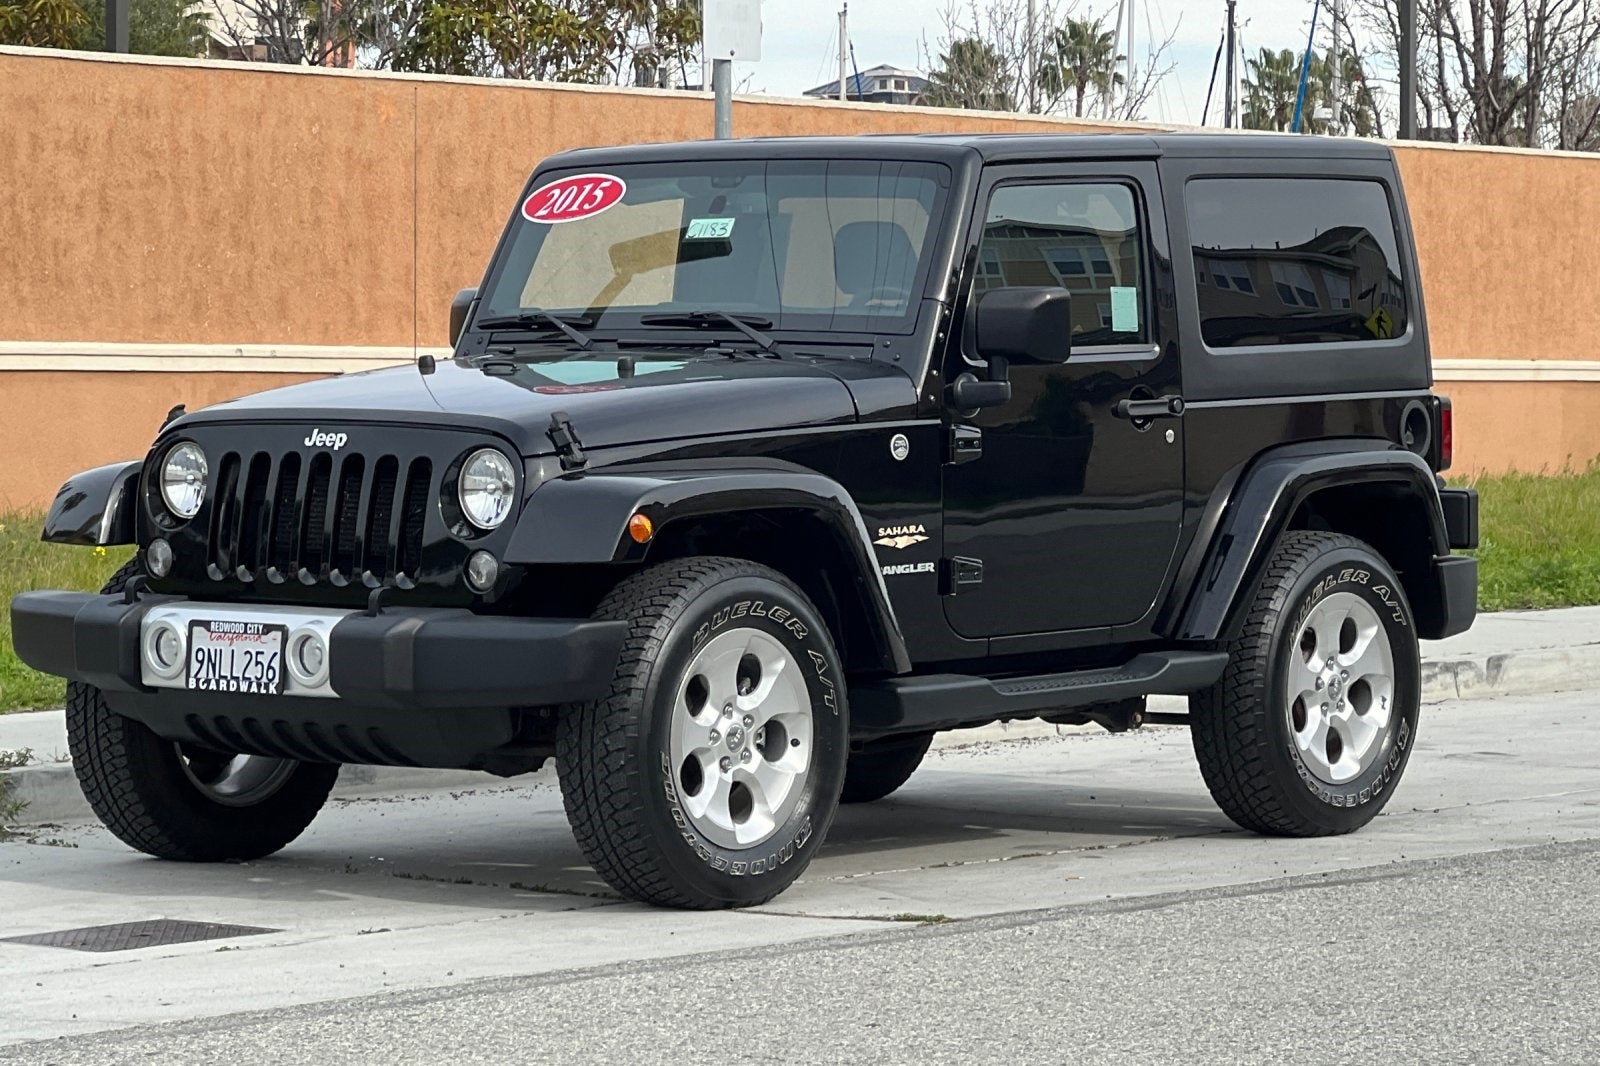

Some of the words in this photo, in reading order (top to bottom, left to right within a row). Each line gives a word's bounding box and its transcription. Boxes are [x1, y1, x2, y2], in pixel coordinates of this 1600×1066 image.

[534, 181, 612, 217] 2015
[304, 428, 348, 451] Jeep
[878, 524, 926, 537] SAHARA
[881, 562, 936, 576] ANGLER
[1372, 585, 1407, 627] A/T
[210, 621, 245, 634] REDWOOD
[246, 623, 264, 635] CITY
[690, 600, 809, 653] DUELER
[209, 632, 268, 647] California
[194, 647, 279, 683] 9NLL256
[189, 677, 278, 694] BOARDWALK
